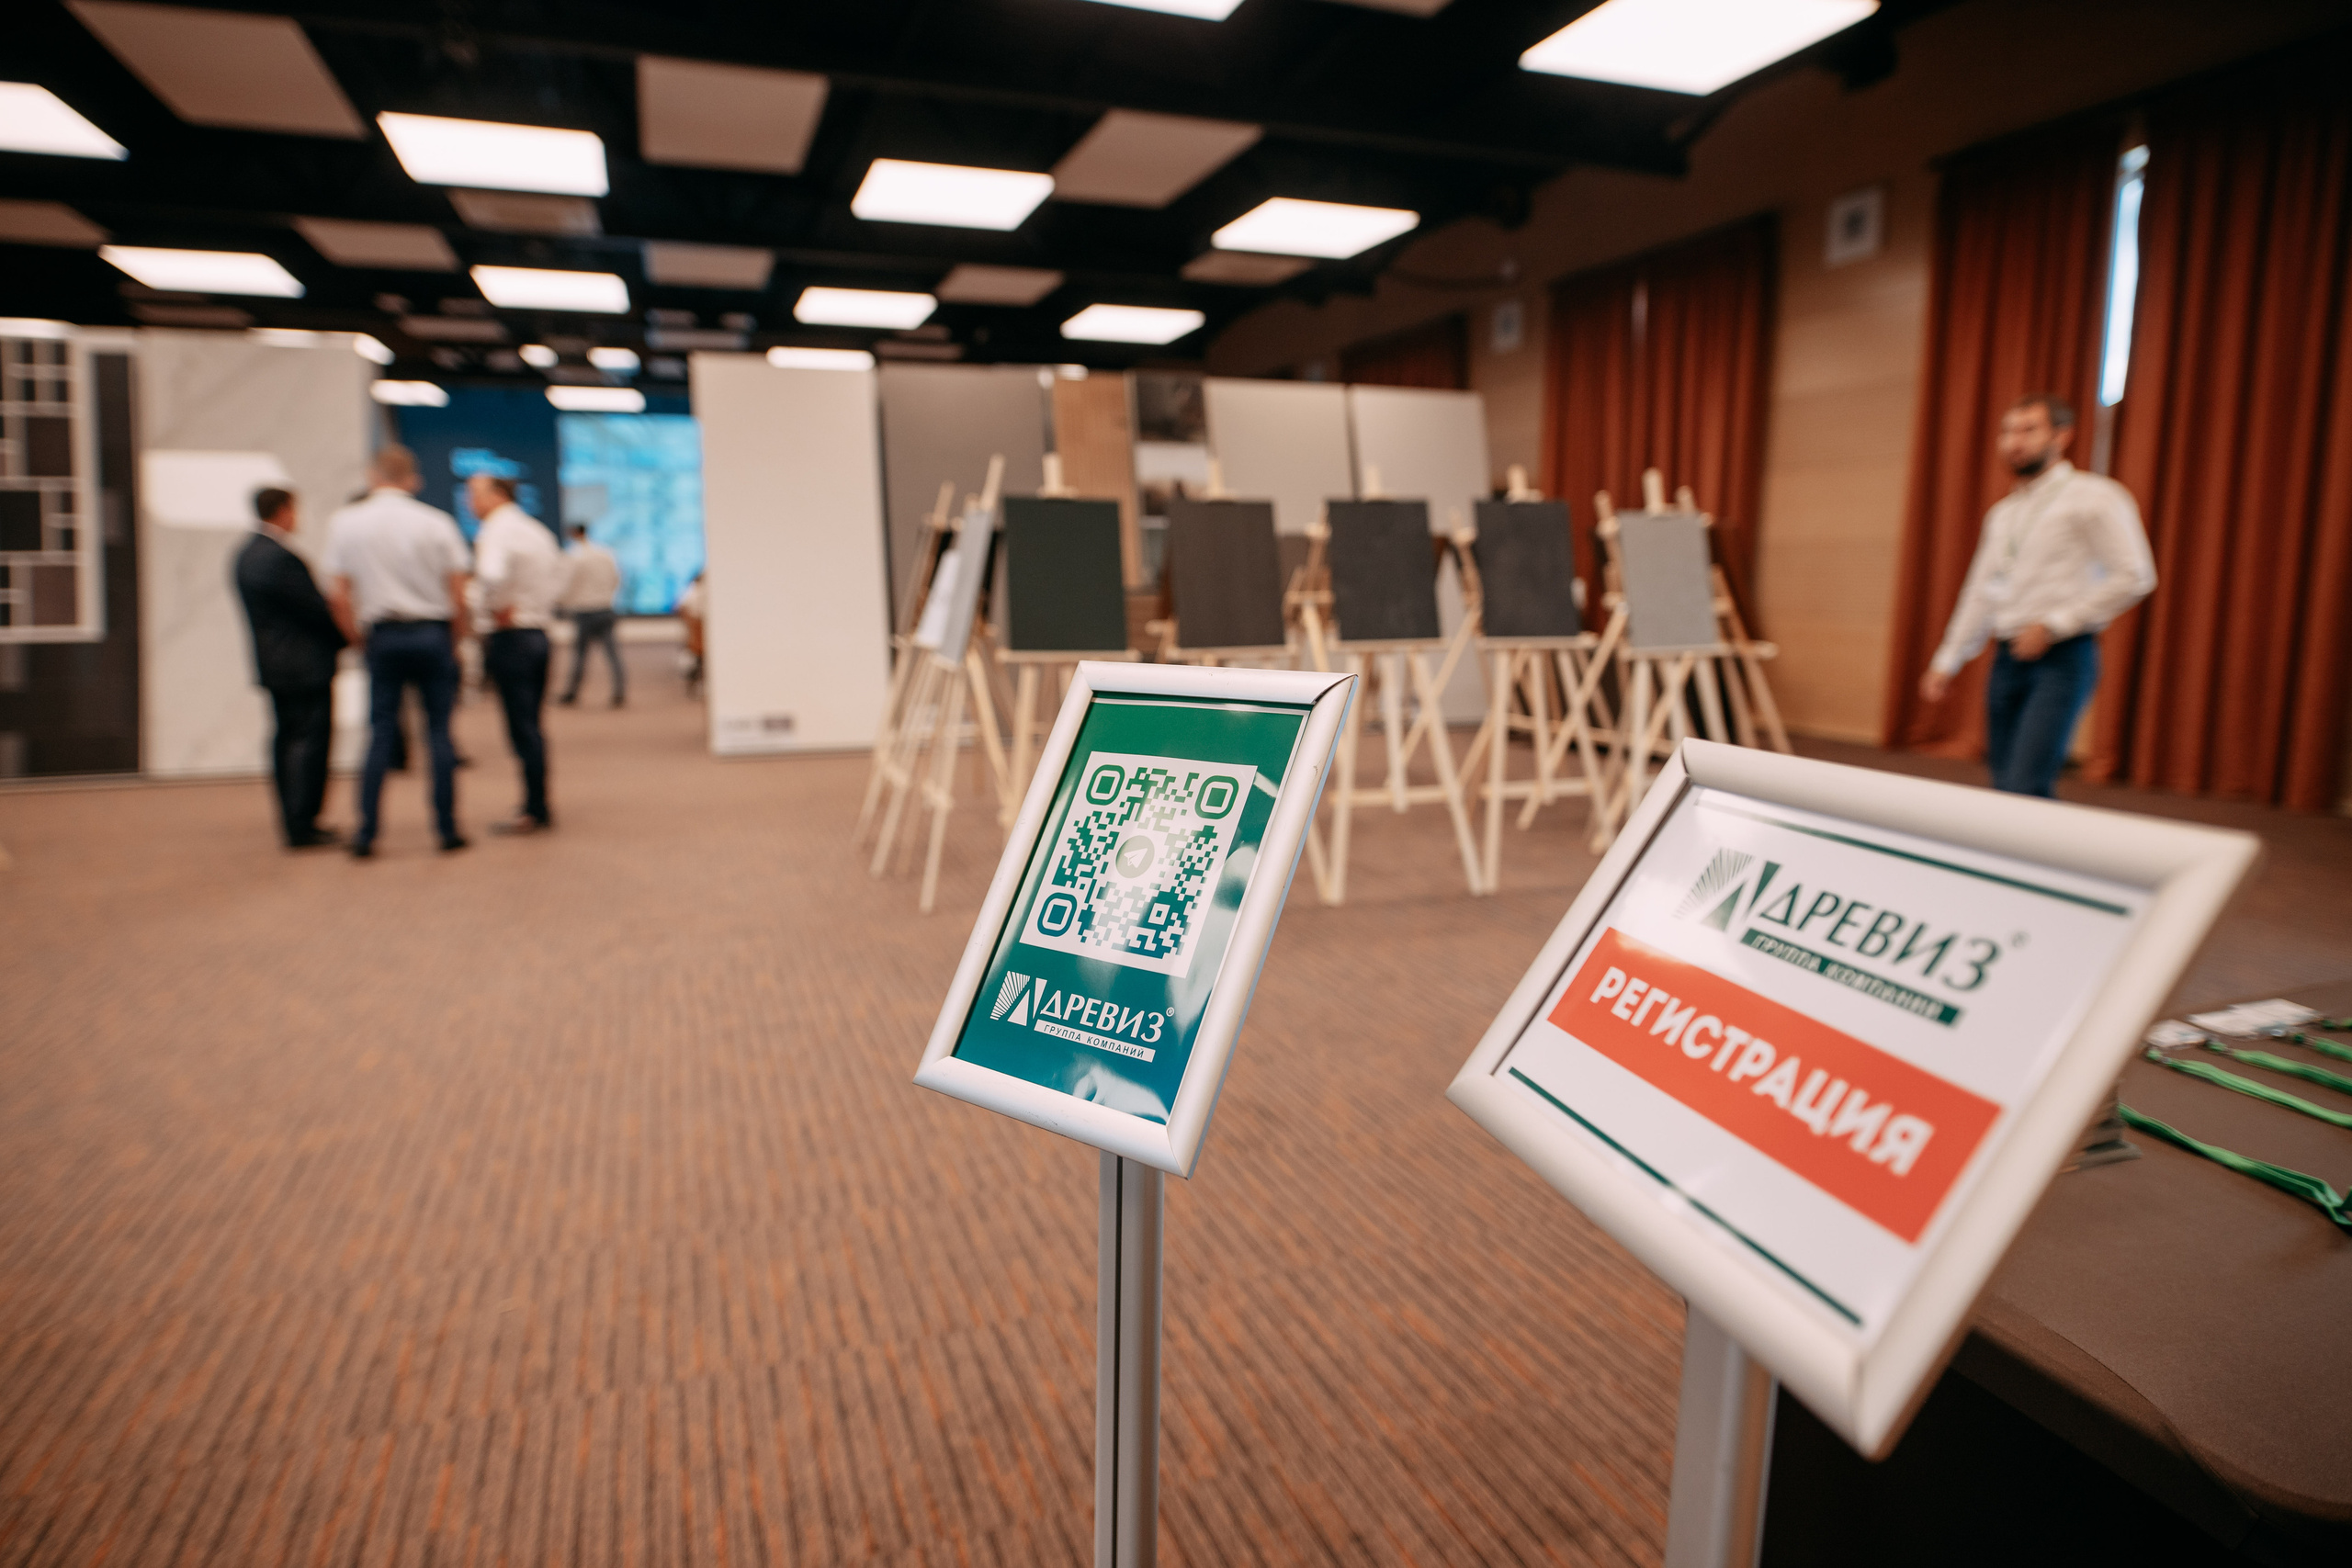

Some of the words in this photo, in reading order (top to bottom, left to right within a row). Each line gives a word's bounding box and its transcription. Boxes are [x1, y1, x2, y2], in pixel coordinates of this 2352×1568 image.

[1758, 883, 2002, 992] ДРЕВИЗ
[1040, 990, 1164, 1043] ДРЕВИЗ
[1044, 1024, 1081, 1041] ГРУППА
[1087, 1036, 1145, 1058] КОМПАНИЙ
[1589, 965, 1934, 1177] РЕГИСТРАЦИЯ
